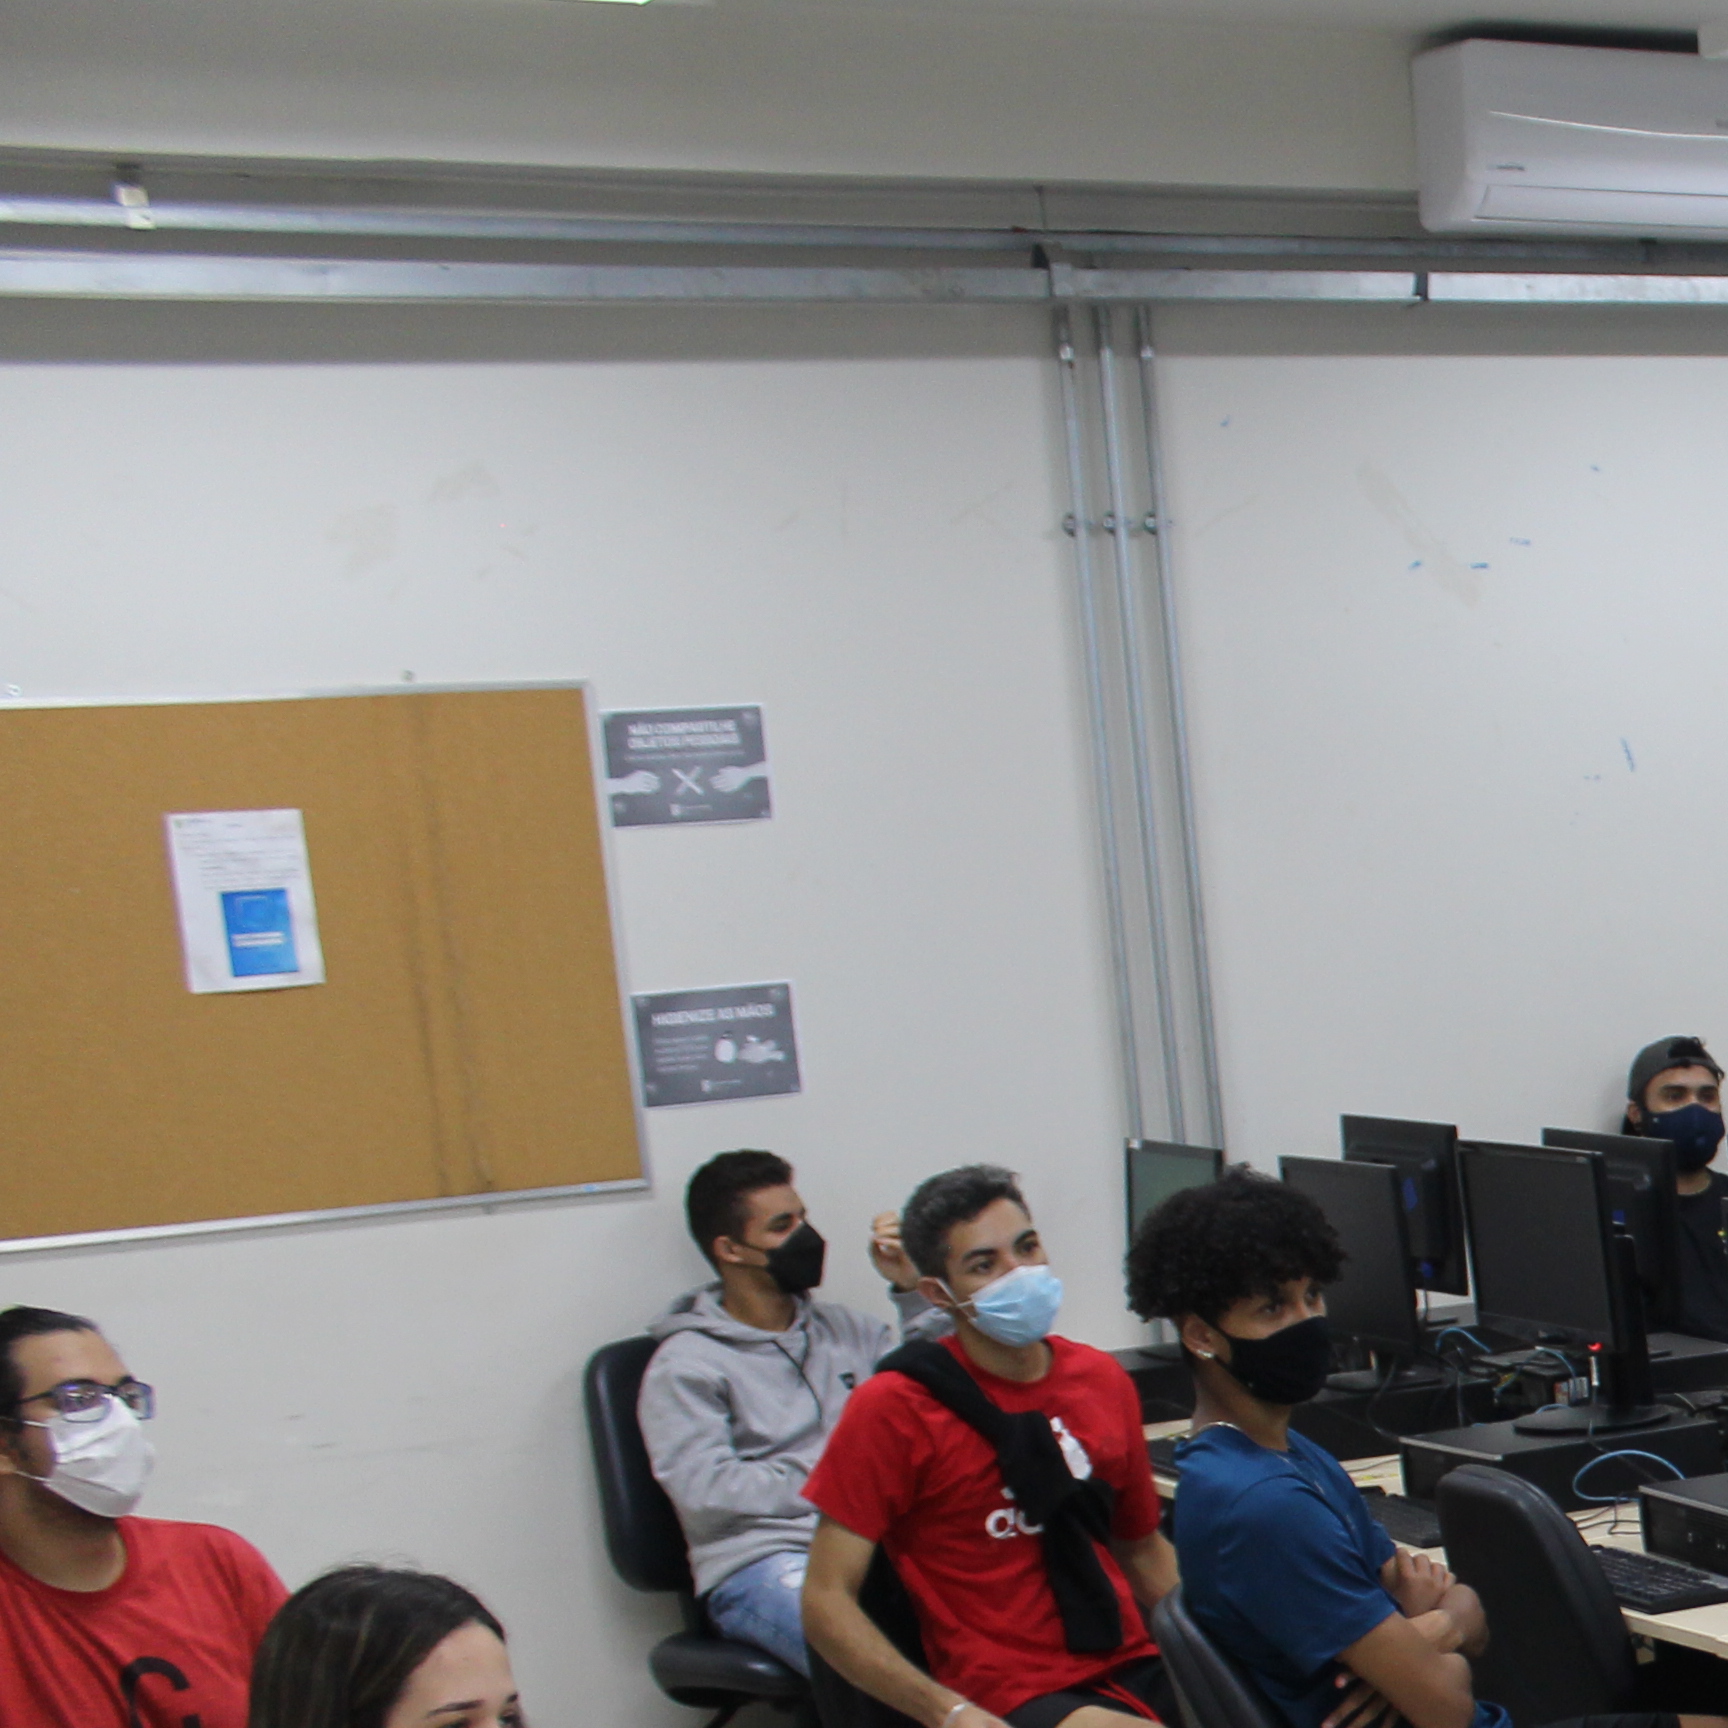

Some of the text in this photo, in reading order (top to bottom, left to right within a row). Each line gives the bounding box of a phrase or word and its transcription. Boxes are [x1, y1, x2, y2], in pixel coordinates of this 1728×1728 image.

[651, 1002, 775, 1027] HIGIENIZE AS MÃOS
